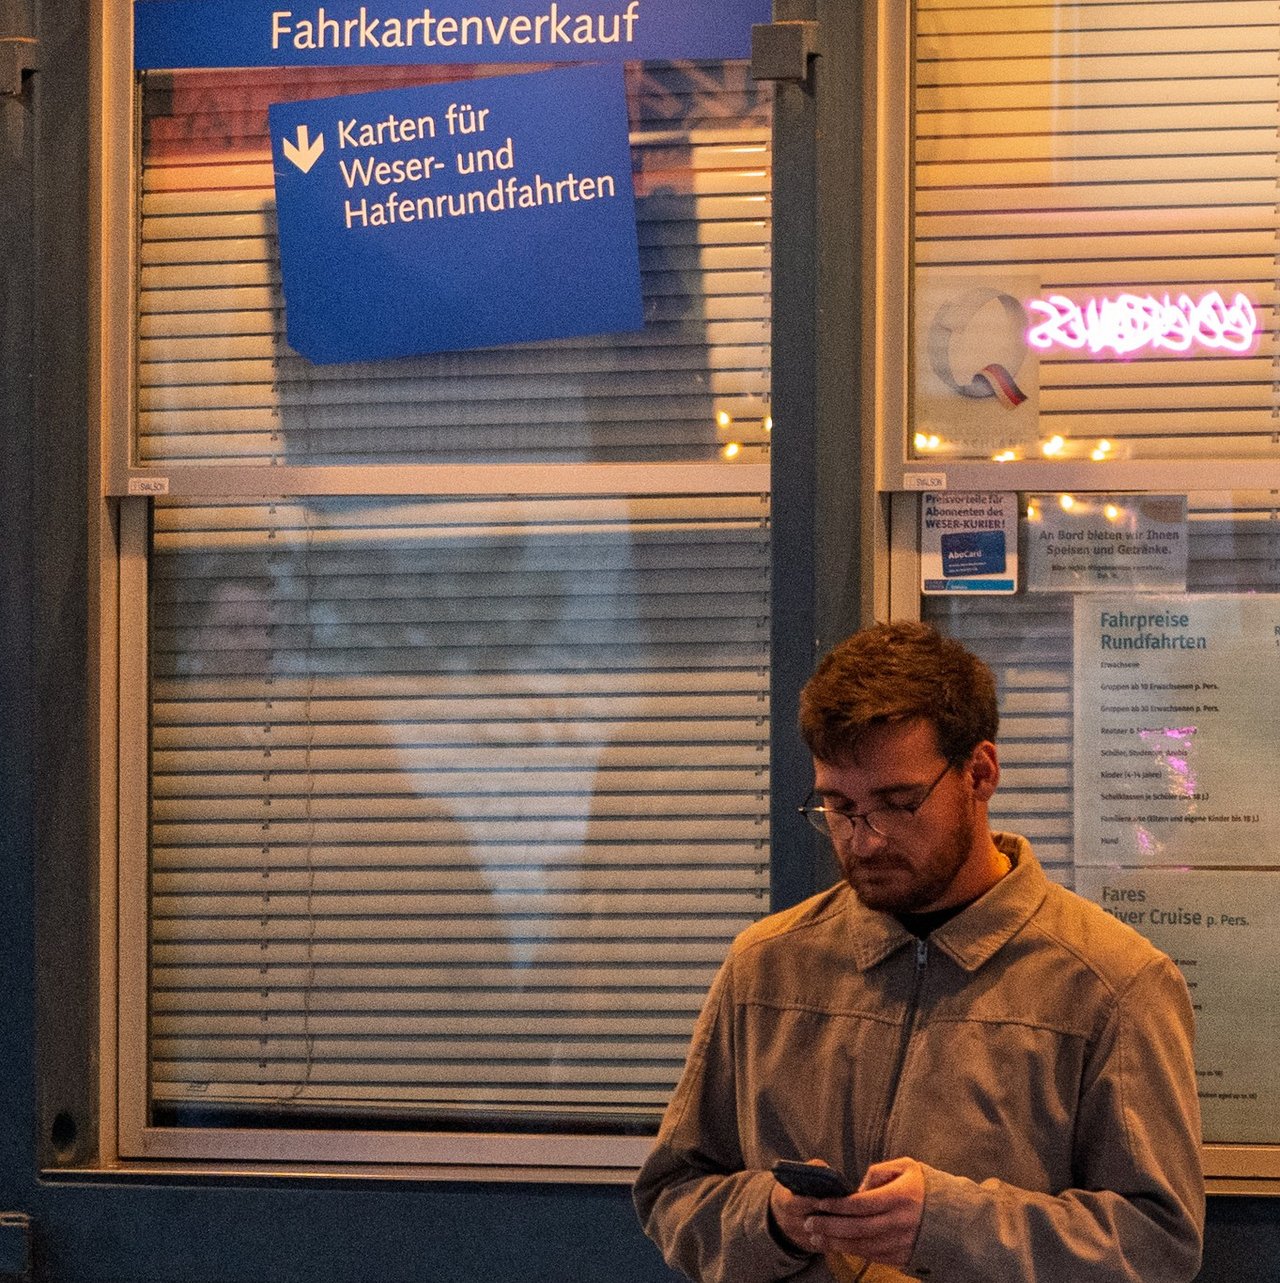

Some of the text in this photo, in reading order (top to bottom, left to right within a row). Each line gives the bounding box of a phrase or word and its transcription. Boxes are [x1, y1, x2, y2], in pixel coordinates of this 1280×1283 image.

[271, 1, 639, 50] Fahrkartenverkauf
[338, 102, 490, 149] Karten für
[340, 138, 514, 188] Weser- und
[344, 171, 615, 229] Hafenrundfahrten
[926, 507, 1004, 517] Abonnenten des
[1039, 530, 1179, 540] An Bord bieten wir Ihnen
[1046, 545, 1090, 556] Speisen
[1093, 545, 1114, 555] und
[1101, 612, 1189, 631] Fahrpreise
[1101, 633, 1207, 651] Rundfahrten
[1102, 886, 1146, 902] Fares
[1103, 907, 1145, 924] iver
[1150, 908, 1202, 925] Cruise
[1221, 915, 1250, 926] Pers.
